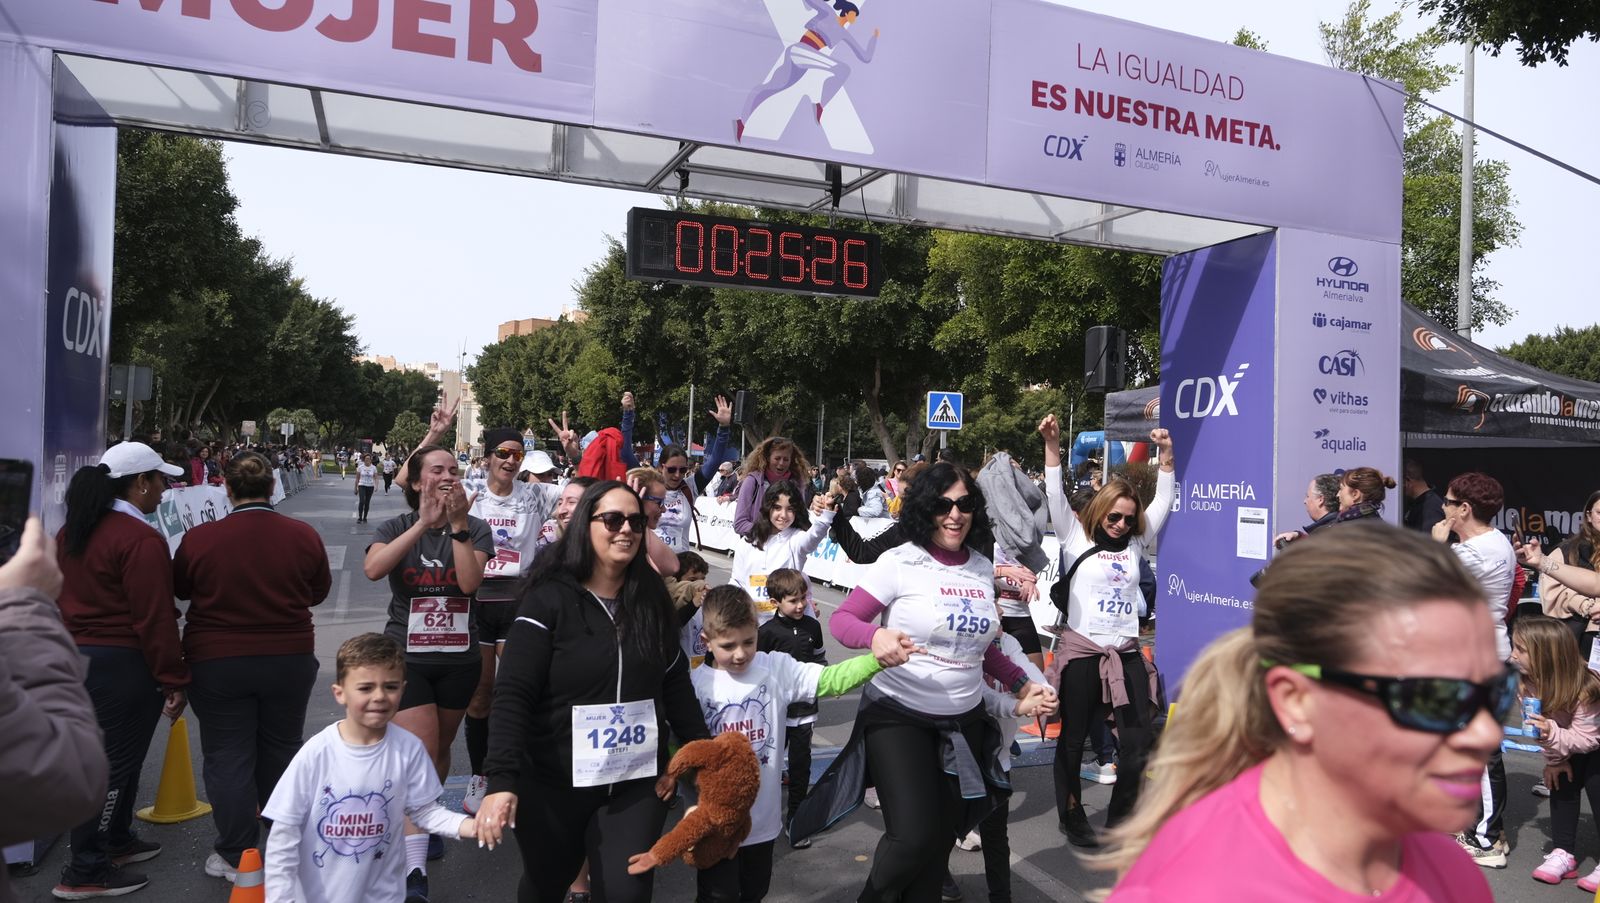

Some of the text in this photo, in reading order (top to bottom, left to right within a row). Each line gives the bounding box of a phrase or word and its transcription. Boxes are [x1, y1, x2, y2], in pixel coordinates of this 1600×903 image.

[77, 0, 542, 73] JER
[1077, 43, 1244, 101] LA IGUALDAD
[1031, 80, 1281, 151] ES NUESTRA META.
[1044, 135, 1088, 161] CDX
[1136, 147, 1181, 166] ALMERÍA
[1135, 160, 1159, 171] CIUDAD
[676, 220, 868, 289] 00:25:26
[1317, 277, 1369, 292] HYUNDAI
[62, 287, 104, 358] CDX
[1330, 317, 1372, 330] cajamar
[1319, 355, 1356, 376] CASI
[1175, 364, 1249, 419] CDX
[1330, 391, 1368, 406] vithas
[1322, 437, 1366, 453] aqualia
[1191, 481, 1255, 500] ALMERÍA
[1191, 501, 1221, 511] CIUDAD
[940, 588, 986, 599] MUJER
[1097, 600, 1132, 615] 1270
[424, 613, 454, 627] 621
[946, 613, 990, 634] 1259
[723, 719, 753, 732] MINI
[587, 724, 646, 749] 1248
[339, 813, 373, 825] MINI
[325, 824, 384, 837] RUNNER
